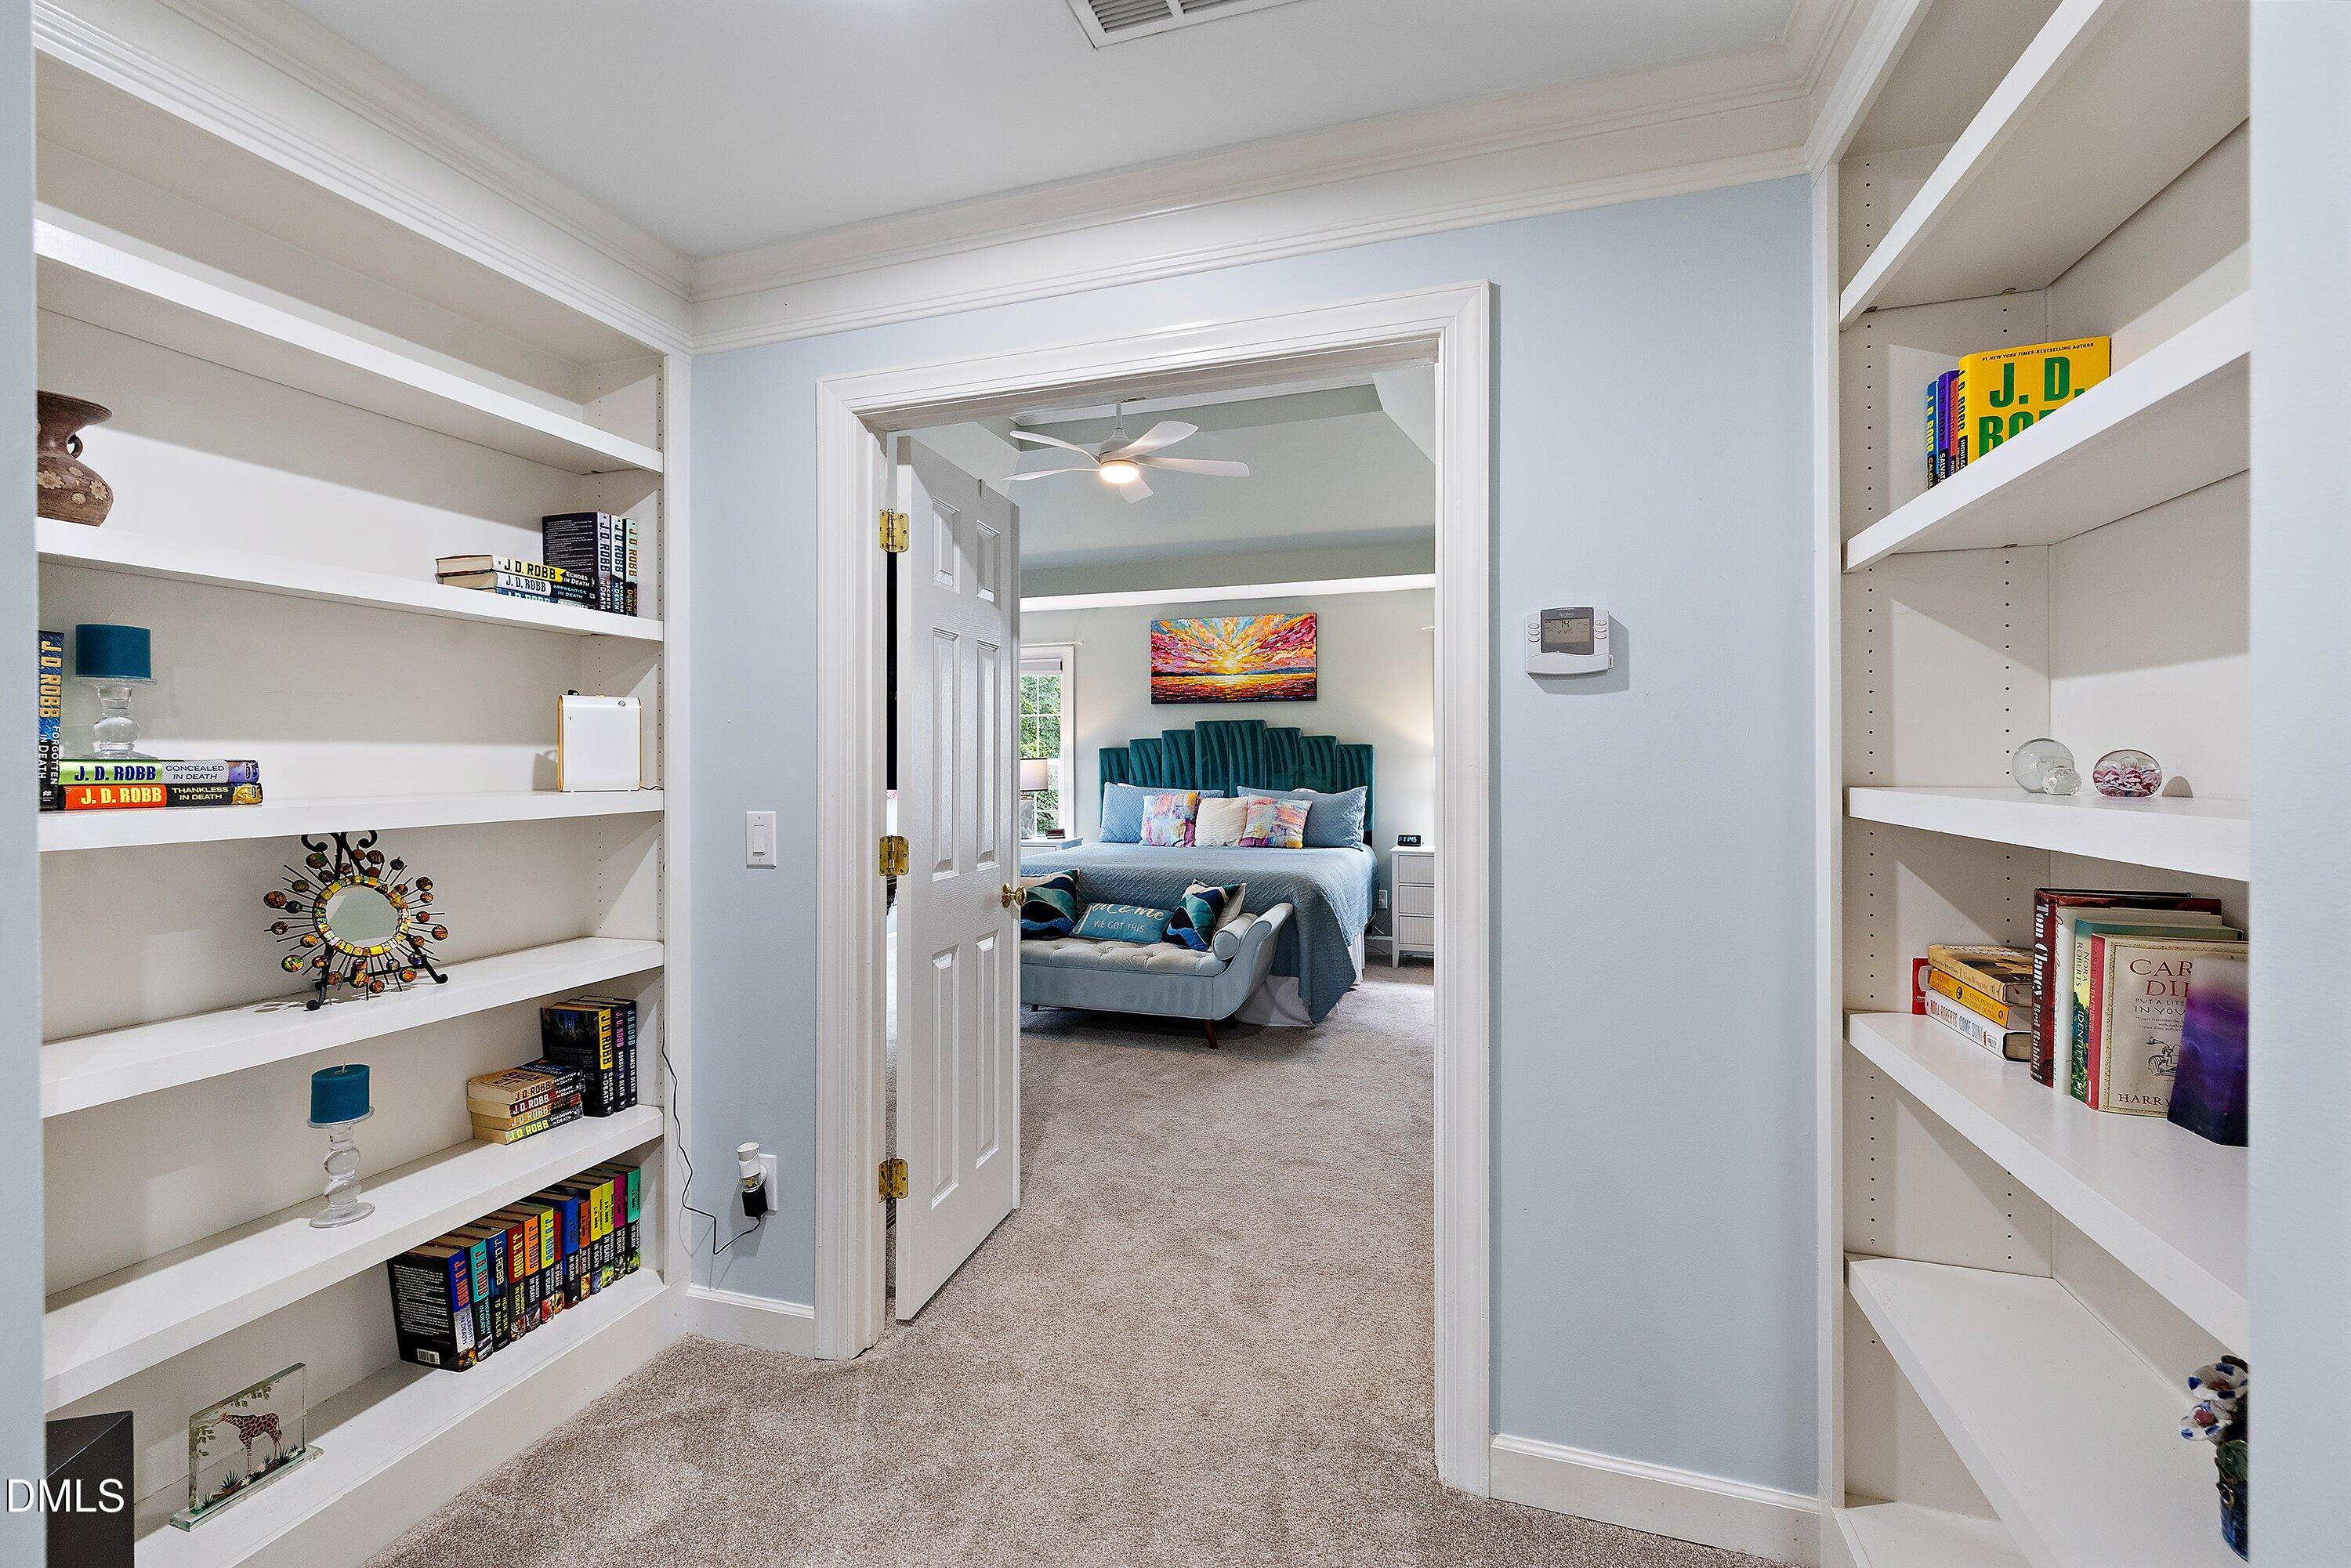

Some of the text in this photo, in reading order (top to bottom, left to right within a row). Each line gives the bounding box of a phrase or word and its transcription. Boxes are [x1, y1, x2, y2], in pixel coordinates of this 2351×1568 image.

[600, 543, 610, 572] ROBB
[614, 545, 624, 573] ROBB
[629, 549, 638, 578] ROBB
[527, 563, 556, 580] ROBB
[566, 570, 588, 581] ECHOES
[524, 580, 546, 593] ROBB
[552, 585, 587, 595] APPRENTICE
[571, 578, 590, 587] DEATH
[39, 674, 62, 719] ROBB
[38, 734, 49, 780] IN DEATH
[49, 725, 61, 785] FORGOTTEN
[74, 766, 157, 781] J. D. ROBB
[80, 787, 163, 805] J. D. ROBB
[1133, 907, 1165, 921] me
[2035, 904, 2049, 939] Tom
[1093, 920, 1145, 932] WE GOT THIS
[2031, 943, 2049, 1001] Clancy
[2129, 958, 2193, 977] CAR
[1930, 999, 1958, 1027] NORA ROBERTS
[1959, 1016, 1971, 1035] COME
[616, 1027, 625, 1048] ROBB
[2076, 1010, 2085, 1063] IDENTITY
[601, 1036, 612, 1065] ROBB
[2032, 1030, 2041, 1070] Rabbit
[551, 1072, 577, 1085] DESPERATION
[531, 1081, 550, 1096] ROBB
[555, 1085, 574, 1095] PAYBACK
[528, 1093, 549, 1110] ROBB
[527, 1105, 549, 1121] ROBB
[550, 1110, 572, 1121] SHADOWS
[525, 1119, 549, 1135] ROBB
[529, 1243, 539, 1269] ROBB
[545, 1236, 555, 1262] ROBB
[495, 1257, 505, 1286] ROBB
[513, 1251, 524, 1279] ROBB
[476, 1269, 488, 1297] ROBB
[529, 1276, 534, 1285] IN
[456, 1278, 469, 1308] ROBB
[514, 1286, 520, 1295] IN
[494, 1298, 501, 1309] TO
